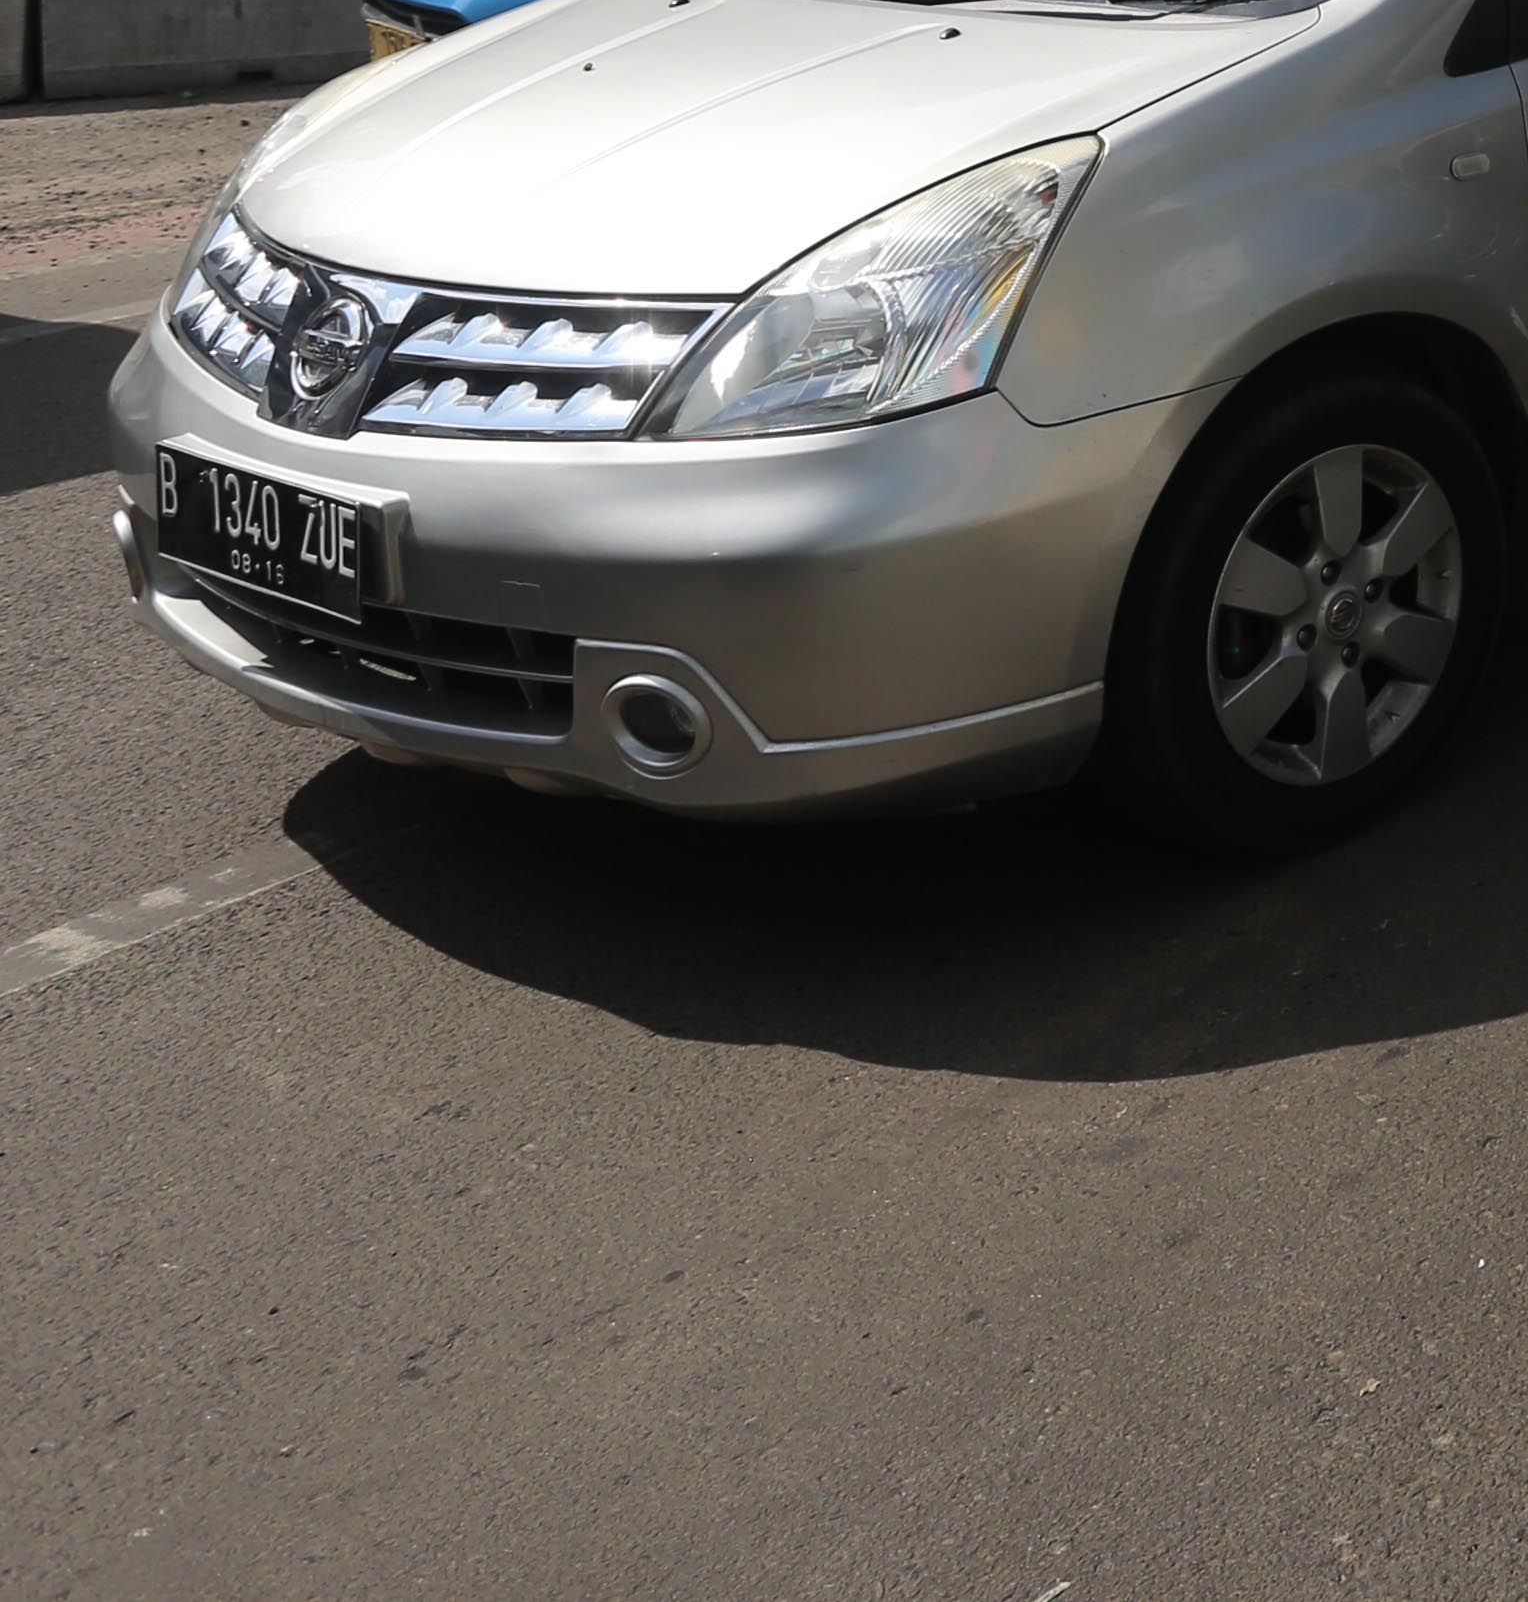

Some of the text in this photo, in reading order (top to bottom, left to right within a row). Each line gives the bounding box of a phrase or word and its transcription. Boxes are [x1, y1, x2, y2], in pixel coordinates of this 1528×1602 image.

[158, 452, 356, 578] B 1340 ZUE
